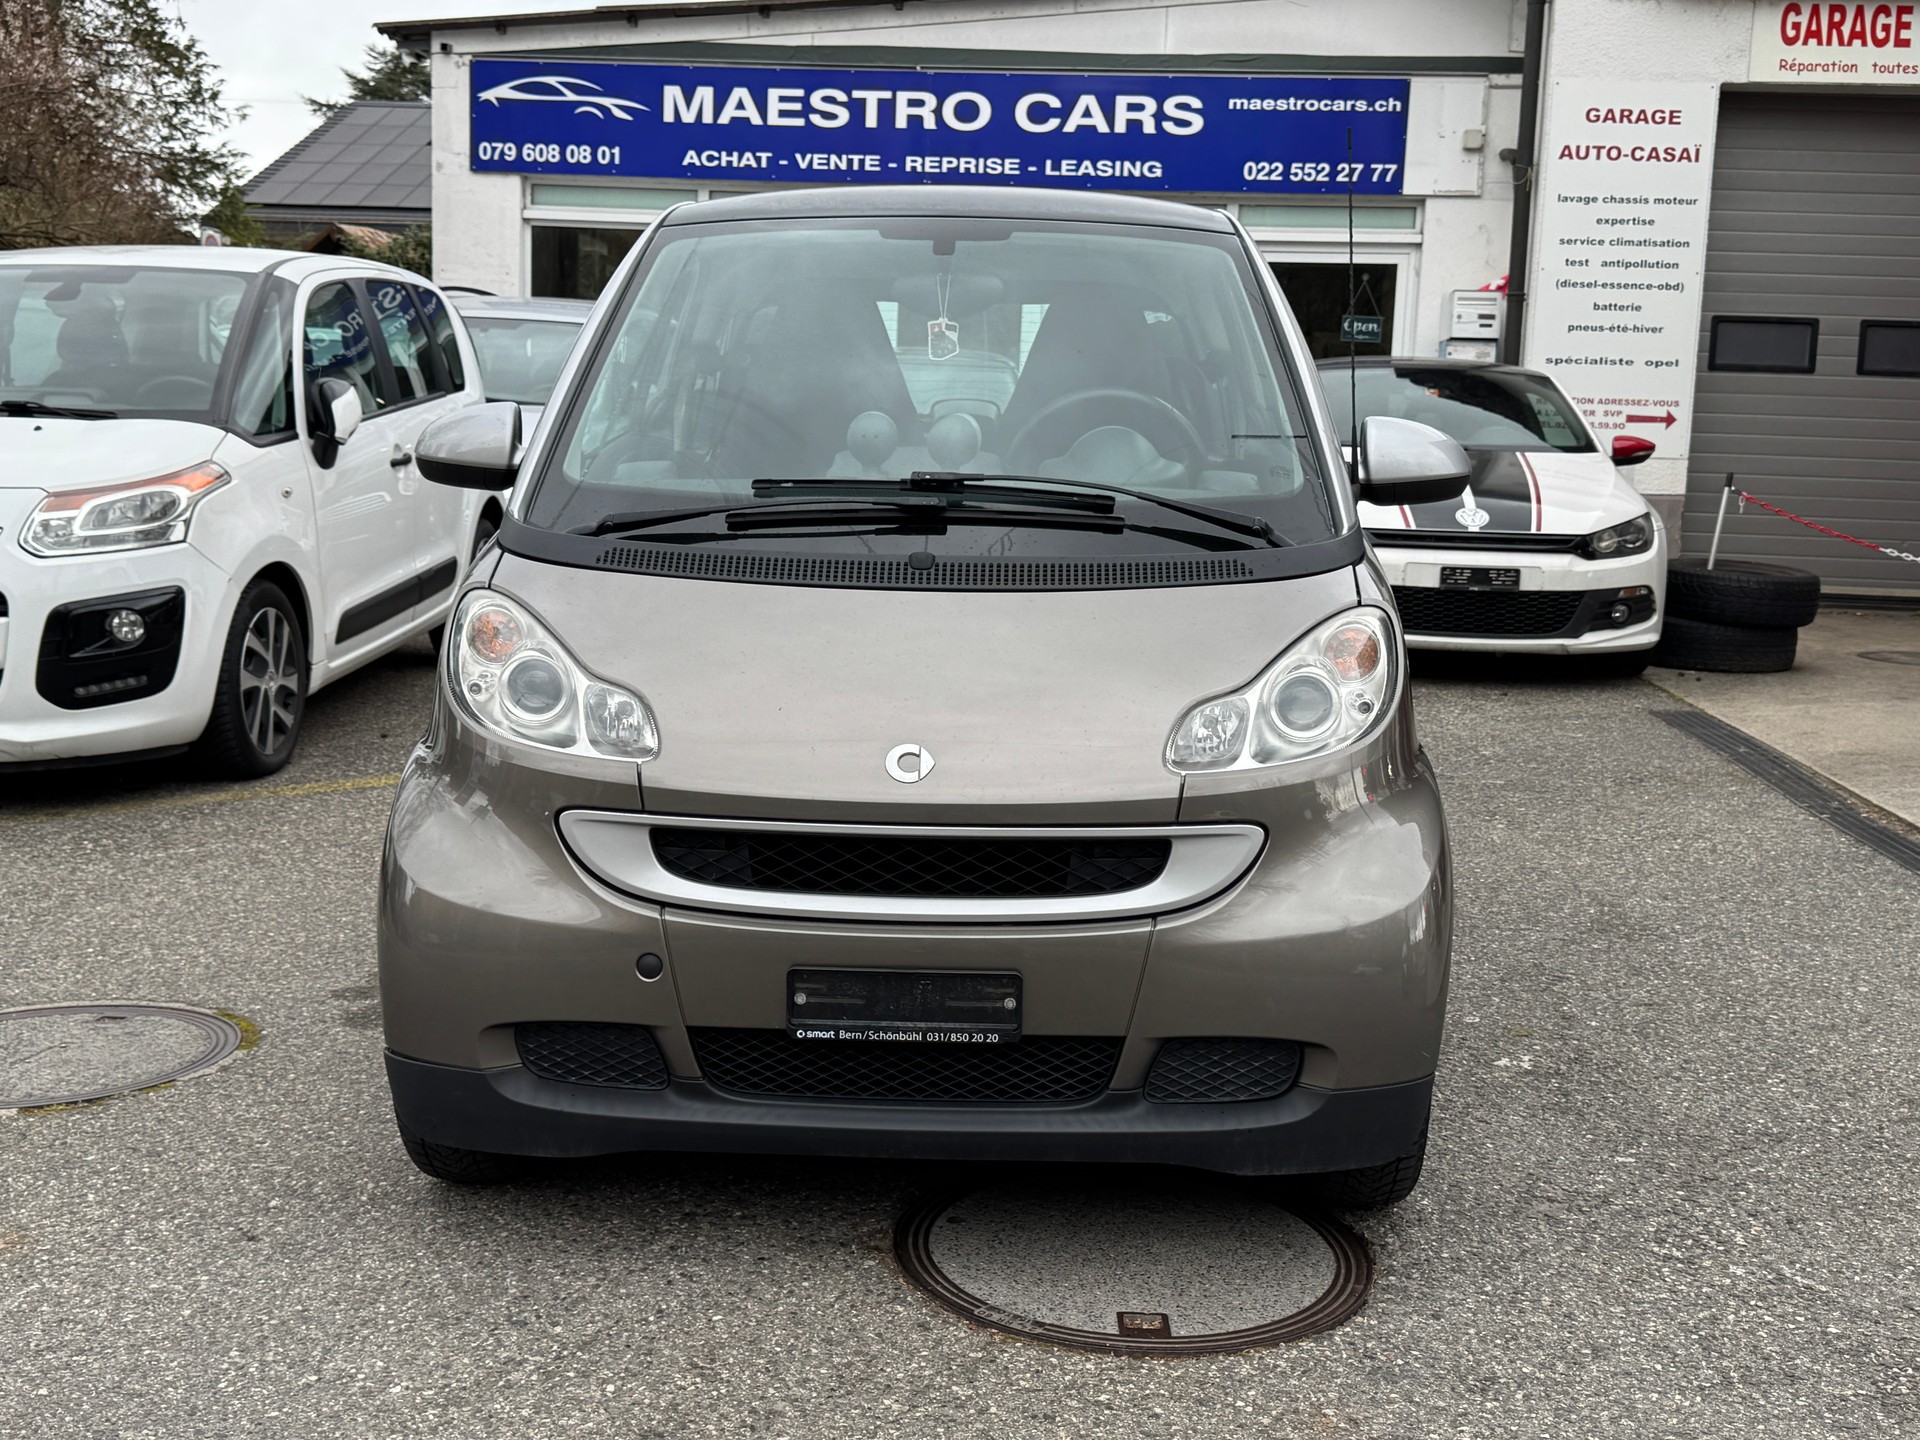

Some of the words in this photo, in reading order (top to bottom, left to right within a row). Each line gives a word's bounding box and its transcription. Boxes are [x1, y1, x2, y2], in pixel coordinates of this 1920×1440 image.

[1780, 2, 1914, 48] GARAGE
[1778, 57, 1858, 76] Réparation
[1871, 61, 1919, 75] toutes
[662, 84, 992, 132] MAESTRO
[1014, 92, 1205, 136] CARS
[1228, 96, 1402, 112] maestrocars.ch
[1585, 107, 1682, 126] GARAGE
[478, 141, 517, 162] 079
[521, 142, 561, 163] 608
[565, 144, 592, 164] 08
[596, 145, 620, 165] 01
[1558, 144, 1702, 163] AUTO-CASAÏ
[681, 149, 773, 168] ACHAT
[794, 152, 881, 172] VENTE
[905, 155, 1021, 175] REPRISE
[1044, 159, 1163, 178] LEASING
[1243, 161, 1284, 181] 022
[1289, 162, 1331, 182] 552
[1335, 162, 1365, 182] 27
[1370, 163, 1398, 183] 77
[1557, 193, 1599, 206] lavage
[1601, 194, 1650, 205] chassis
[1653, 196, 1699, 206] moteur
[1595, 216, 1656, 227] expertise
[1558, 236, 1606, 247] service
[1608, 237, 1690, 248] climatisation
[1565, 257, 1590, 268] test
[1600, 258, 1680, 271] antipollution
[1555, 278, 1685, 293] (diesel-essence-obd)
[1592, 301, 1643, 313] batterie
[1567, 324, 1664, 334] pneus-été-hiver
[1545, 356, 1635, 367] spécialiste
[1644, 358, 1680, 369] opel
[1596, 397, 1680, 408] ADRESSEZ-VOUS
[1602, 409, 1623, 418] SVP
[806, 1030, 836, 1039] smart
[839, 1029, 922, 1042] Bern/Schönbühl
[926, 1031, 969, 1043] 031/850
[971, 1033, 984, 1043] 20
[986, 1033, 999, 1043] 20
